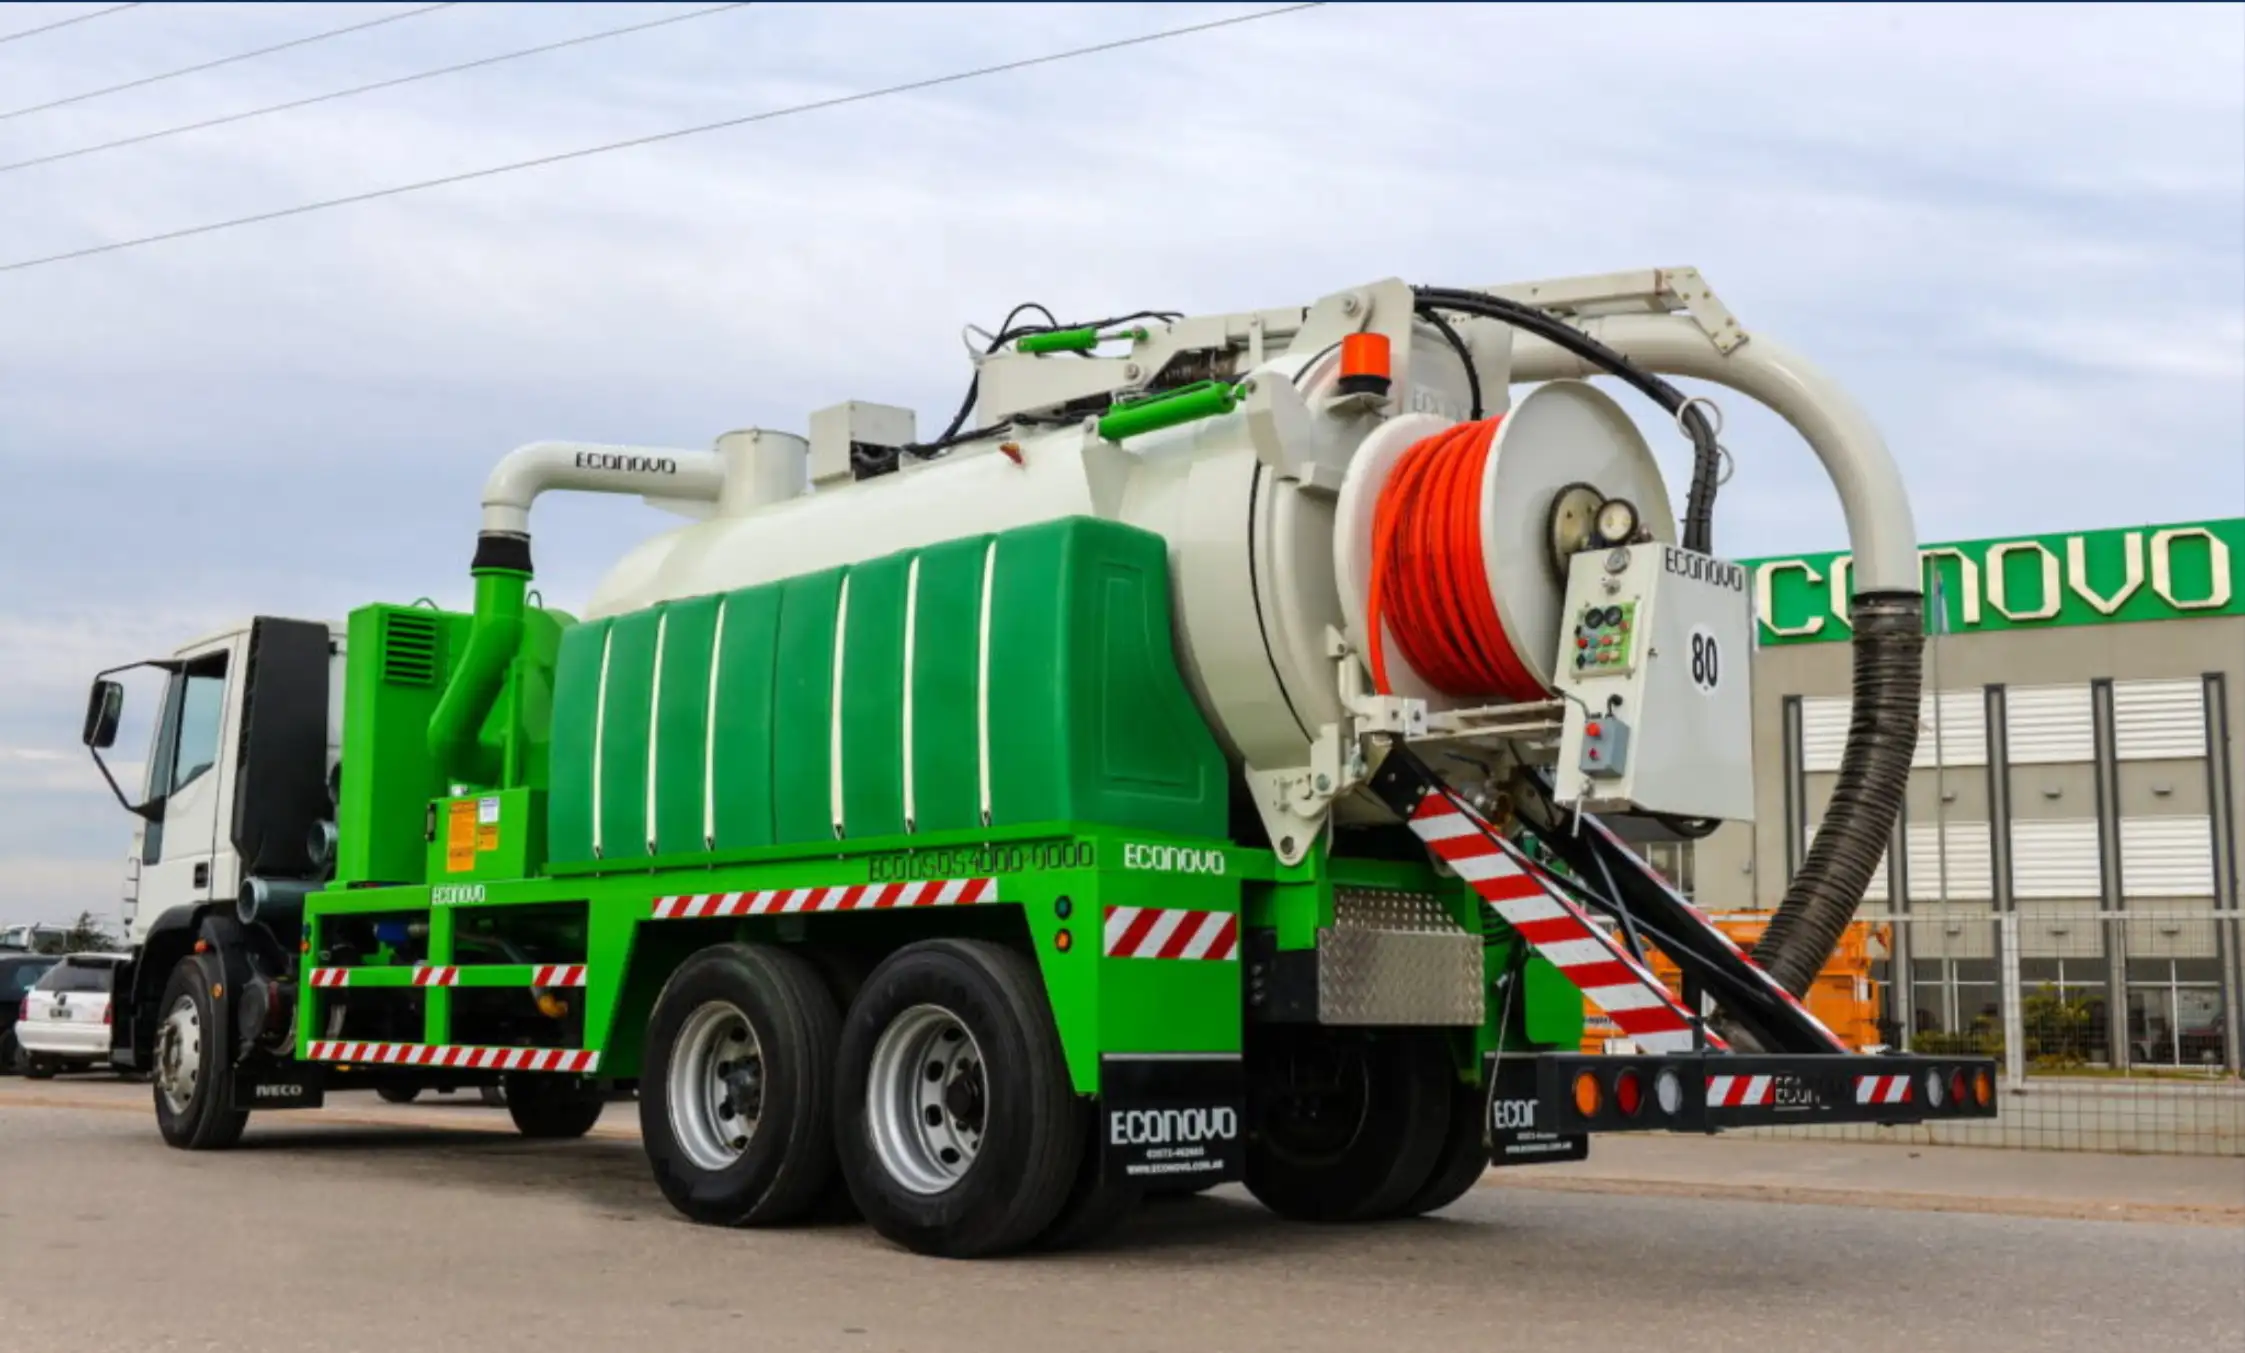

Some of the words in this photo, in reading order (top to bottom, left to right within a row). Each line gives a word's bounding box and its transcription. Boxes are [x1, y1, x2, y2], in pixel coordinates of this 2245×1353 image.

[576, 451, 676, 474] ECONOVO
[1665, 547, 1743, 592] ECONOVO
[1755, 527, 2232, 636] CNOVO
[1692, 632, 1718, 687] 80
[1124, 843, 1225, 875] ECONOVO
[256, 1084, 302, 1098] IVECO
[1111, 1106, 1237, 1144] ECONOVO
